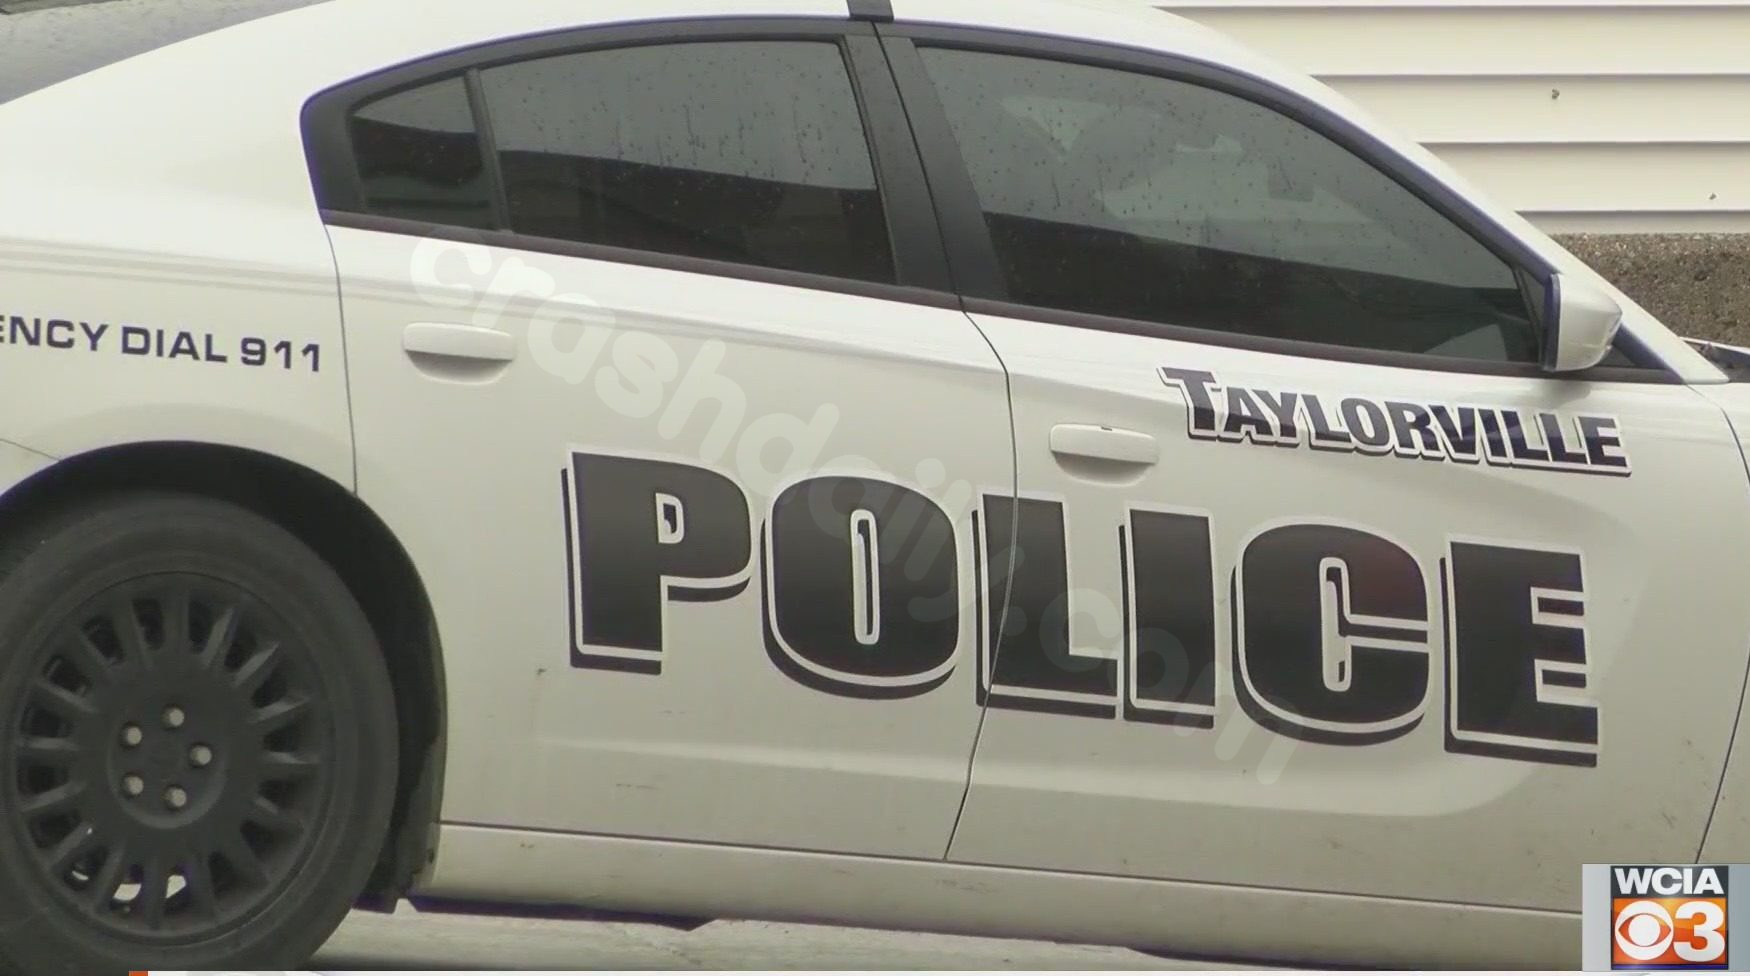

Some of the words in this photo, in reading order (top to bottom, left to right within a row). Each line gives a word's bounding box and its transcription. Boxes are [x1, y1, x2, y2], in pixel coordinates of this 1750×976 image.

[0, 315, 109, 351] NCY
[121, 326, 228, 363] DIAL
[241, 337, 320, 372] 911
[562, 445, 1600, 767] POLICE
